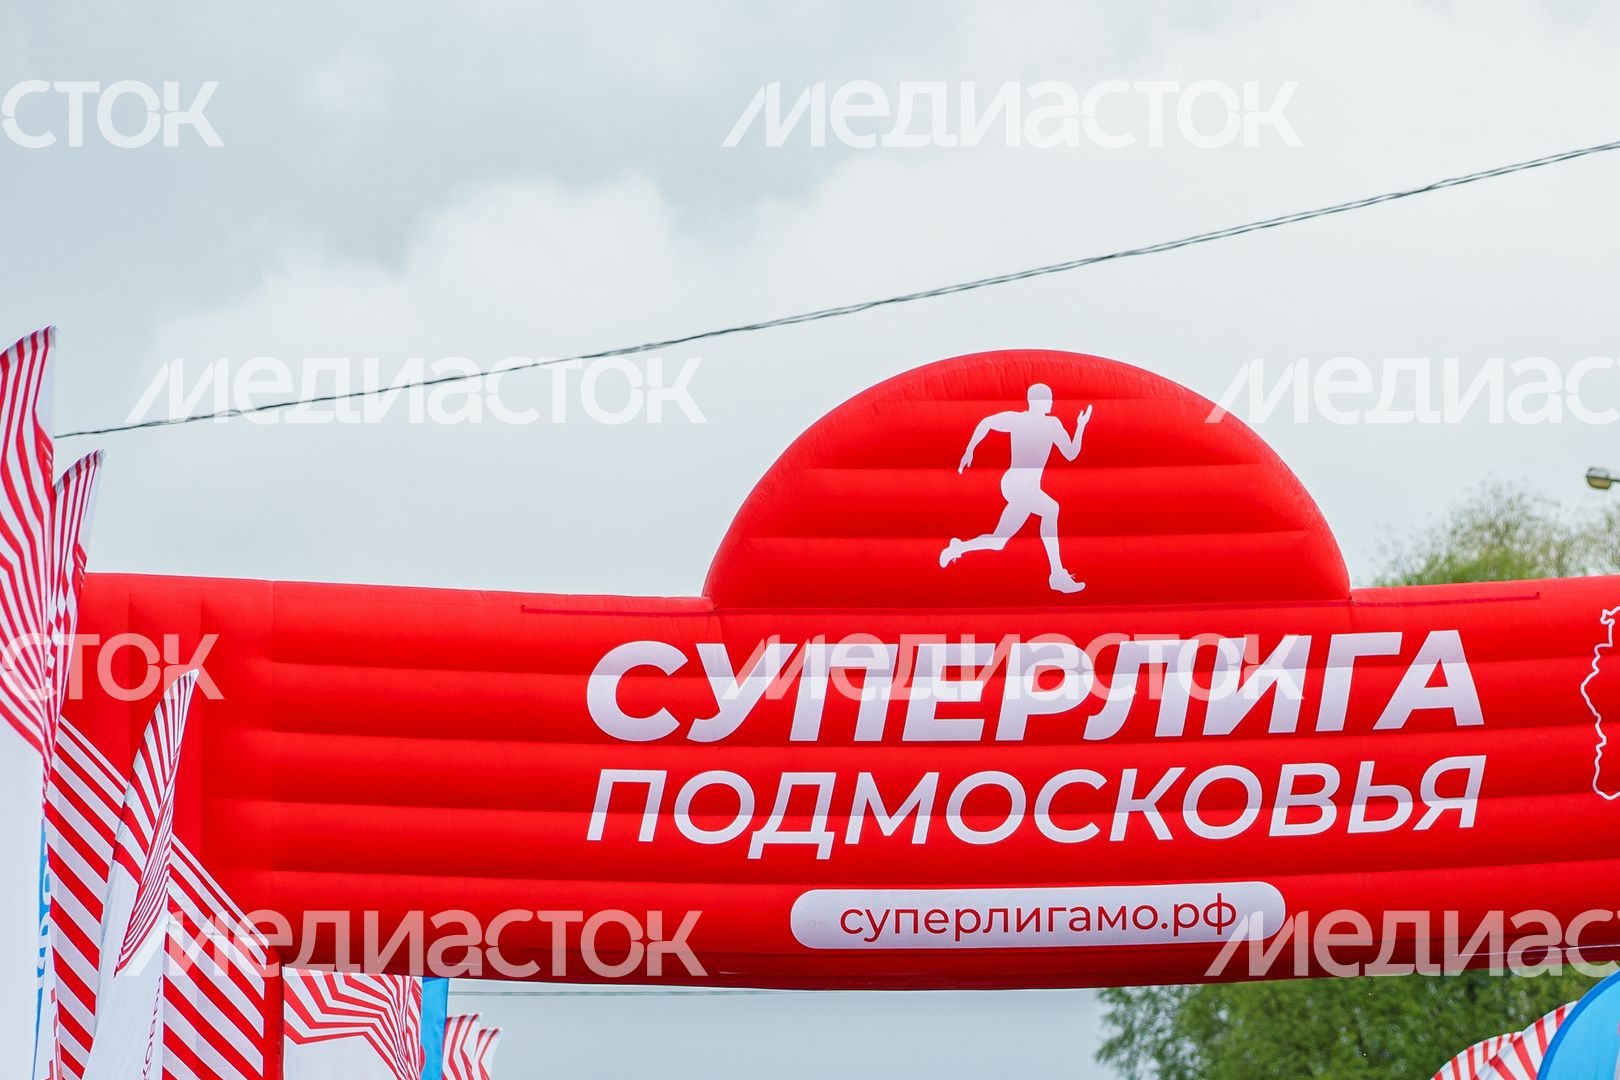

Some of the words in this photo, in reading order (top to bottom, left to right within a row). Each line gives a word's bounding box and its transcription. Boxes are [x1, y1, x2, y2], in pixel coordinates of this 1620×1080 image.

[586, 629, 1484, 744] СУПЕРЛИГА
[586, 755, 1487, 860] ПОДМОСКОВЬЯ
[839, 893, 1238, 945] суперлигамо.рф
